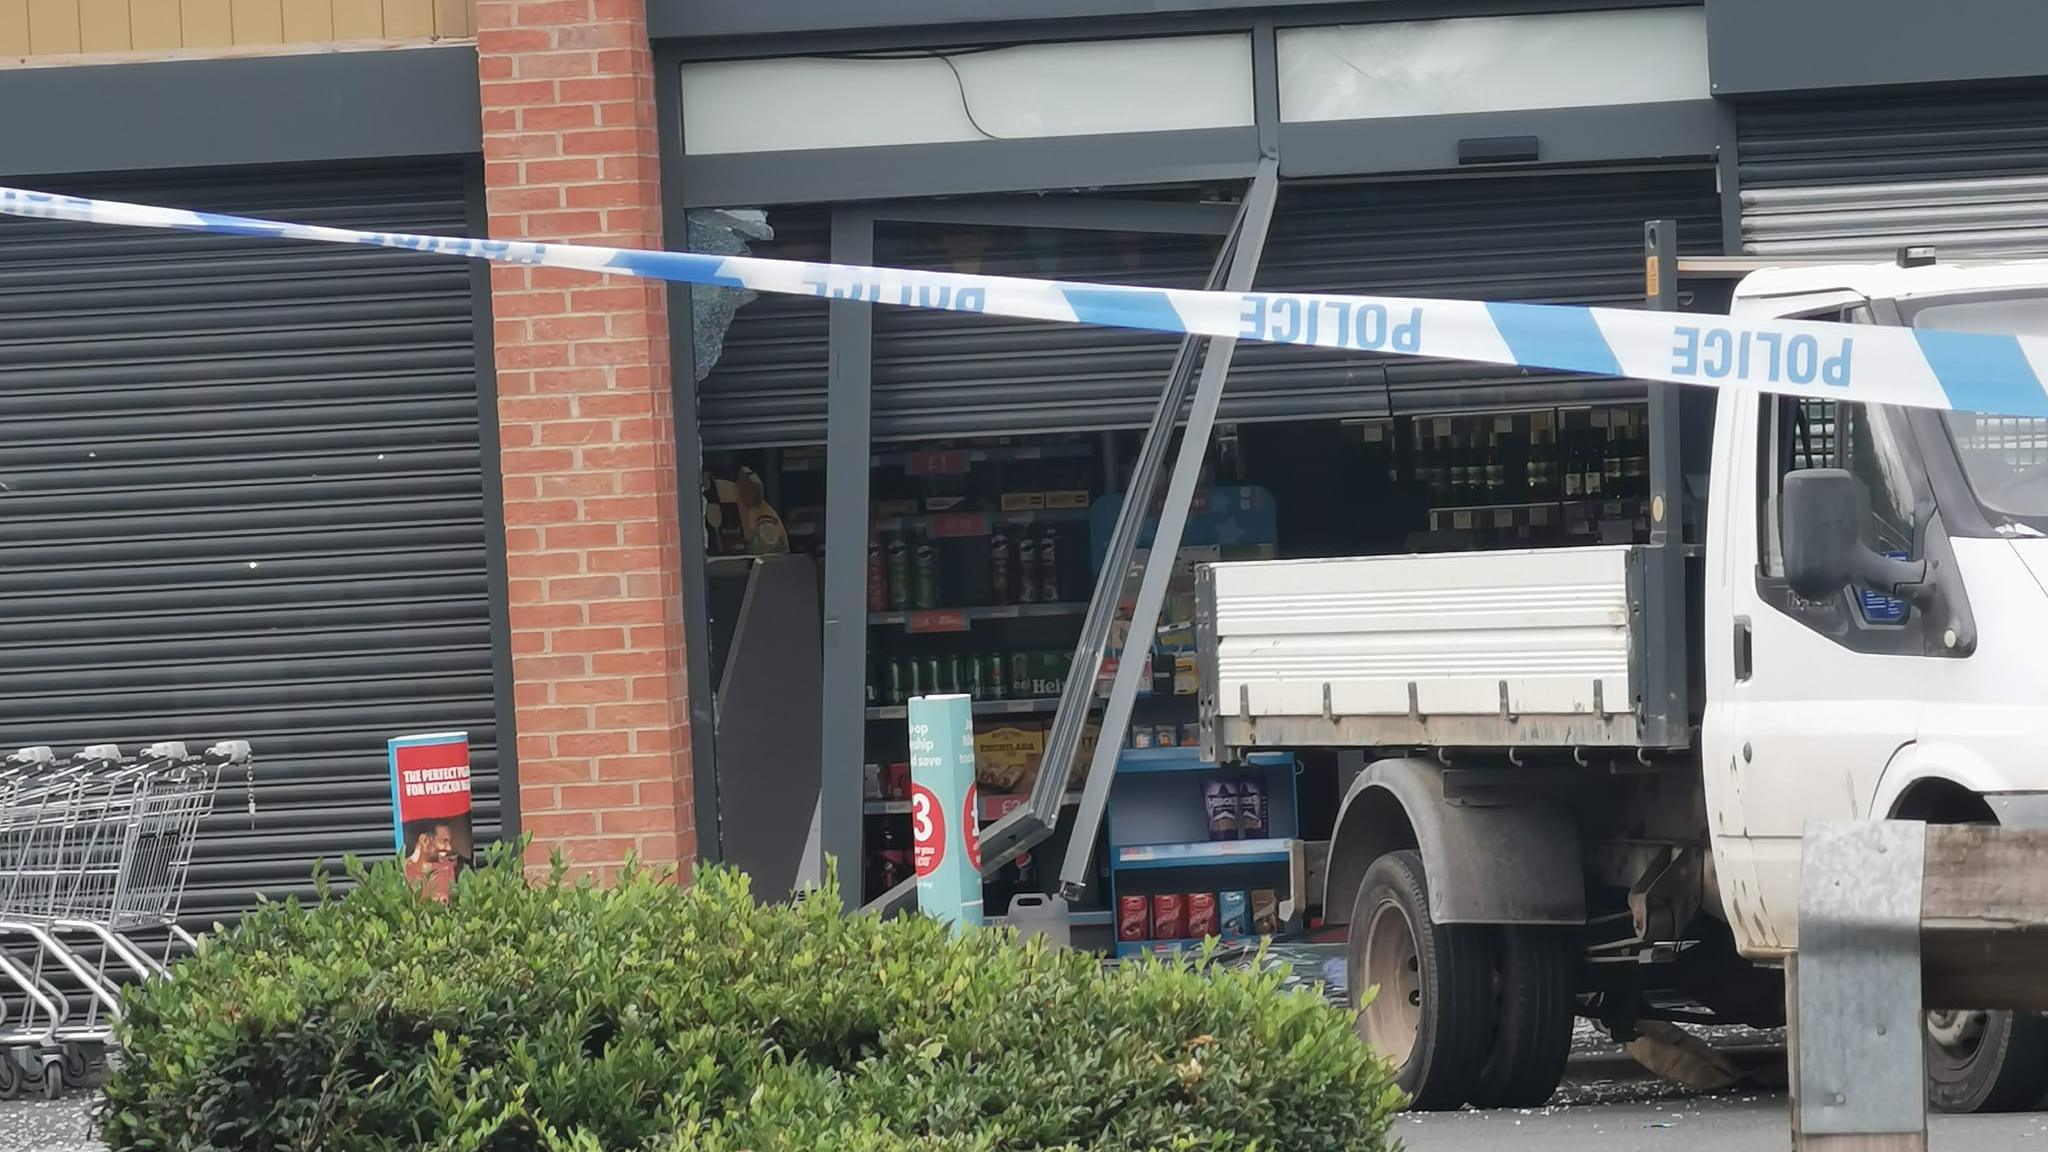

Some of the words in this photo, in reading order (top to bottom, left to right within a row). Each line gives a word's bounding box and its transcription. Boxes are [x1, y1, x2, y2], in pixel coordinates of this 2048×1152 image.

[1239, 295, 1423, 353] POLICE
[1671, 326, 1853, 387] POLICE
[918, 757, 942, 767] save
[403, 769, 422, 783] THE
[421, 767, 458, 781] PERFECT
[405, 783, 426, 796] FOR
